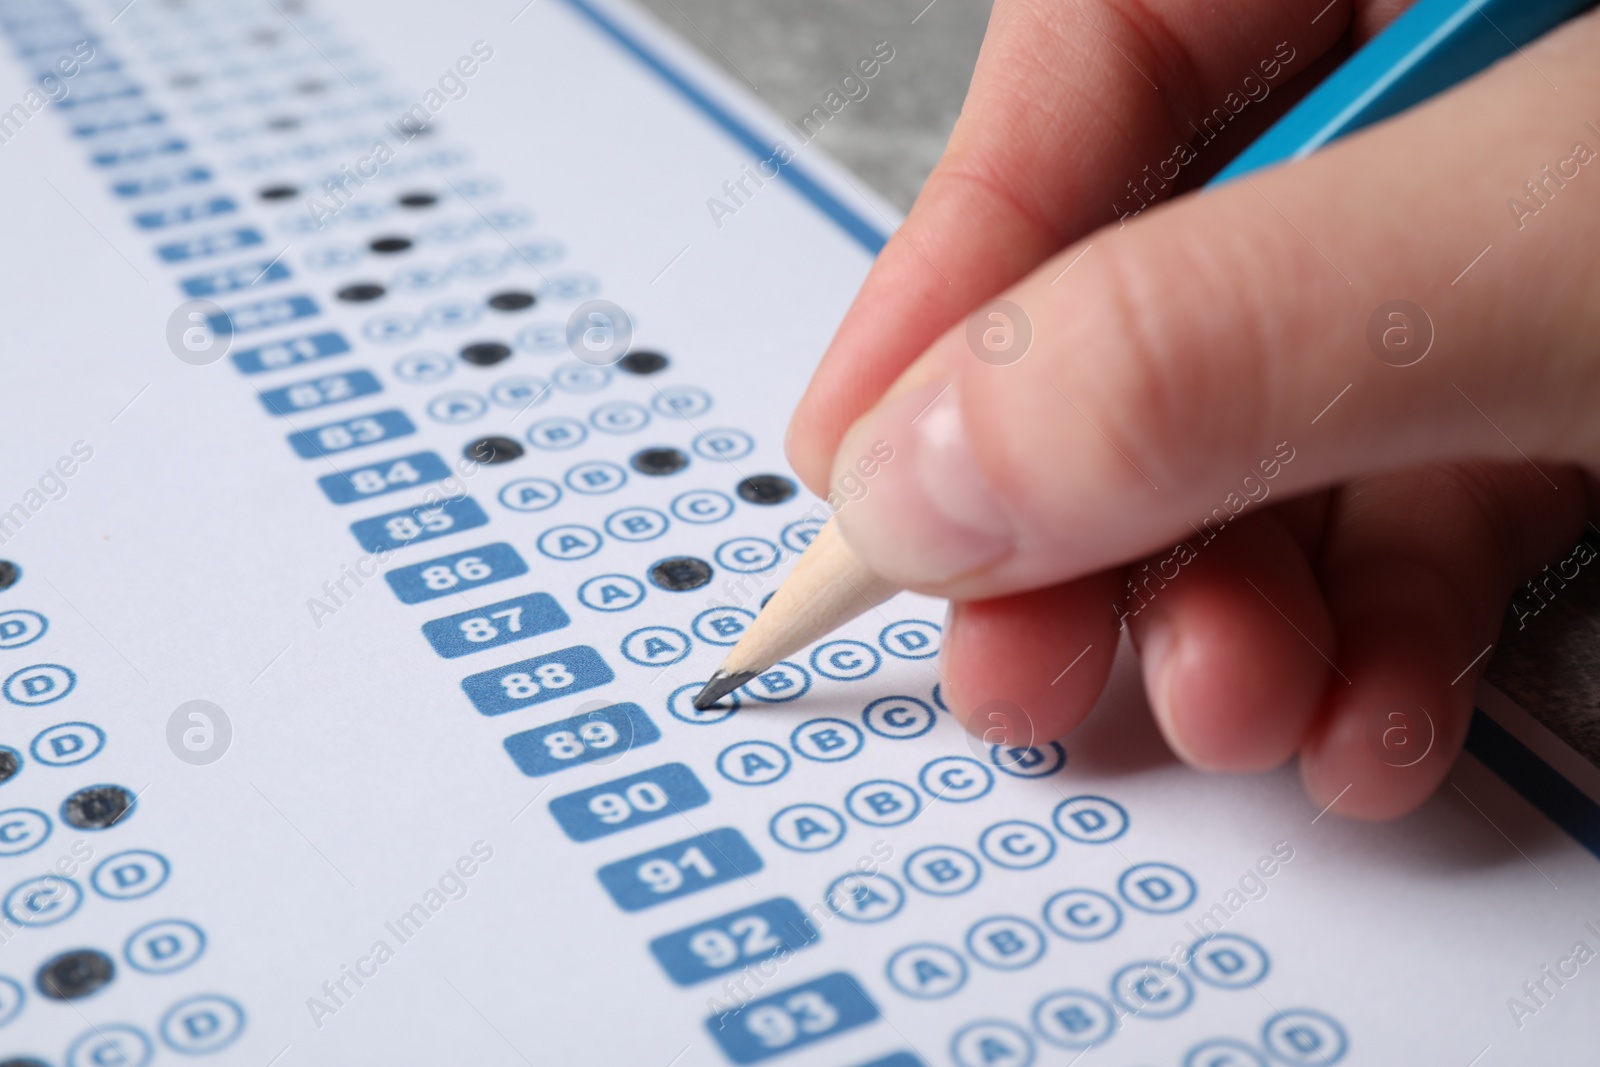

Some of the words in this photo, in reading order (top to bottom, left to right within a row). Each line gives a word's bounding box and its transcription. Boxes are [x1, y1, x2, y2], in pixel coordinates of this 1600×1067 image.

[320, 419, 384, 449] 83
[351, 461, 419, 494] 84
[385, 506, 454, 540] 85
[519, 487, 547, 505] A
[581, 470, 611, 487] B
[707, 438, 736, 455] D
[421, 556, 492, 591] 86
[559, 534, 588, 553] A
[621, 516, 653, 534] B
[688, 499, 718, 516] C
[460, 606, 523, 643] 87
[600, 584, 632, 605] A
[732, 546, 764, 565] C
[0, 619, 28, 641] D
[500, 662, 575, 700] 88
[644, 636, 678, 659] A
[709, 616, 745, 638] B
[21, 674, 56, 698] D
[543, 721, 619, 760] 89
[757, 670, 795, 694] B
[829, 650, 863, 671] C
[894, 630, 930, 652] D
[49, 733, 84, 758] D
[589, 781, 669, 824] 90
[740, 752, 776, 777] A
[808, 728, 847, 753] B
[882, 706, 917, 729] C
[0, 821, 30, 844] C
[638, 847, 715, 893] 91
[794, 816, 830, 842] A
[864, 791, 903, 817] B
[939, 768, 975, 791] C
[1007, 745, 1047, 769] D
[111, 863, 148, 889] D
[691, 916, 778, 967] 92
[851, 885, 888, 912] A
[923, 858, 963, 885] B
[999, 833, 1036, 857] C
[1070, 808, 1108, 834] D
[146, 934, 183, 962] D
[748, 993, 836, 1046] 93
[913, 959, 949, 986] A
[986, 929, 1026, 957] B
[1064, 902, 1101, 928] C
[1136, 876, 1175, 903] D
[1132, 975, 1172, 1003] C
[1206, 948, 1246, 977] D
[183, 1011, 220, 1040] D
[1282, 1026, 1323, 1056] D
